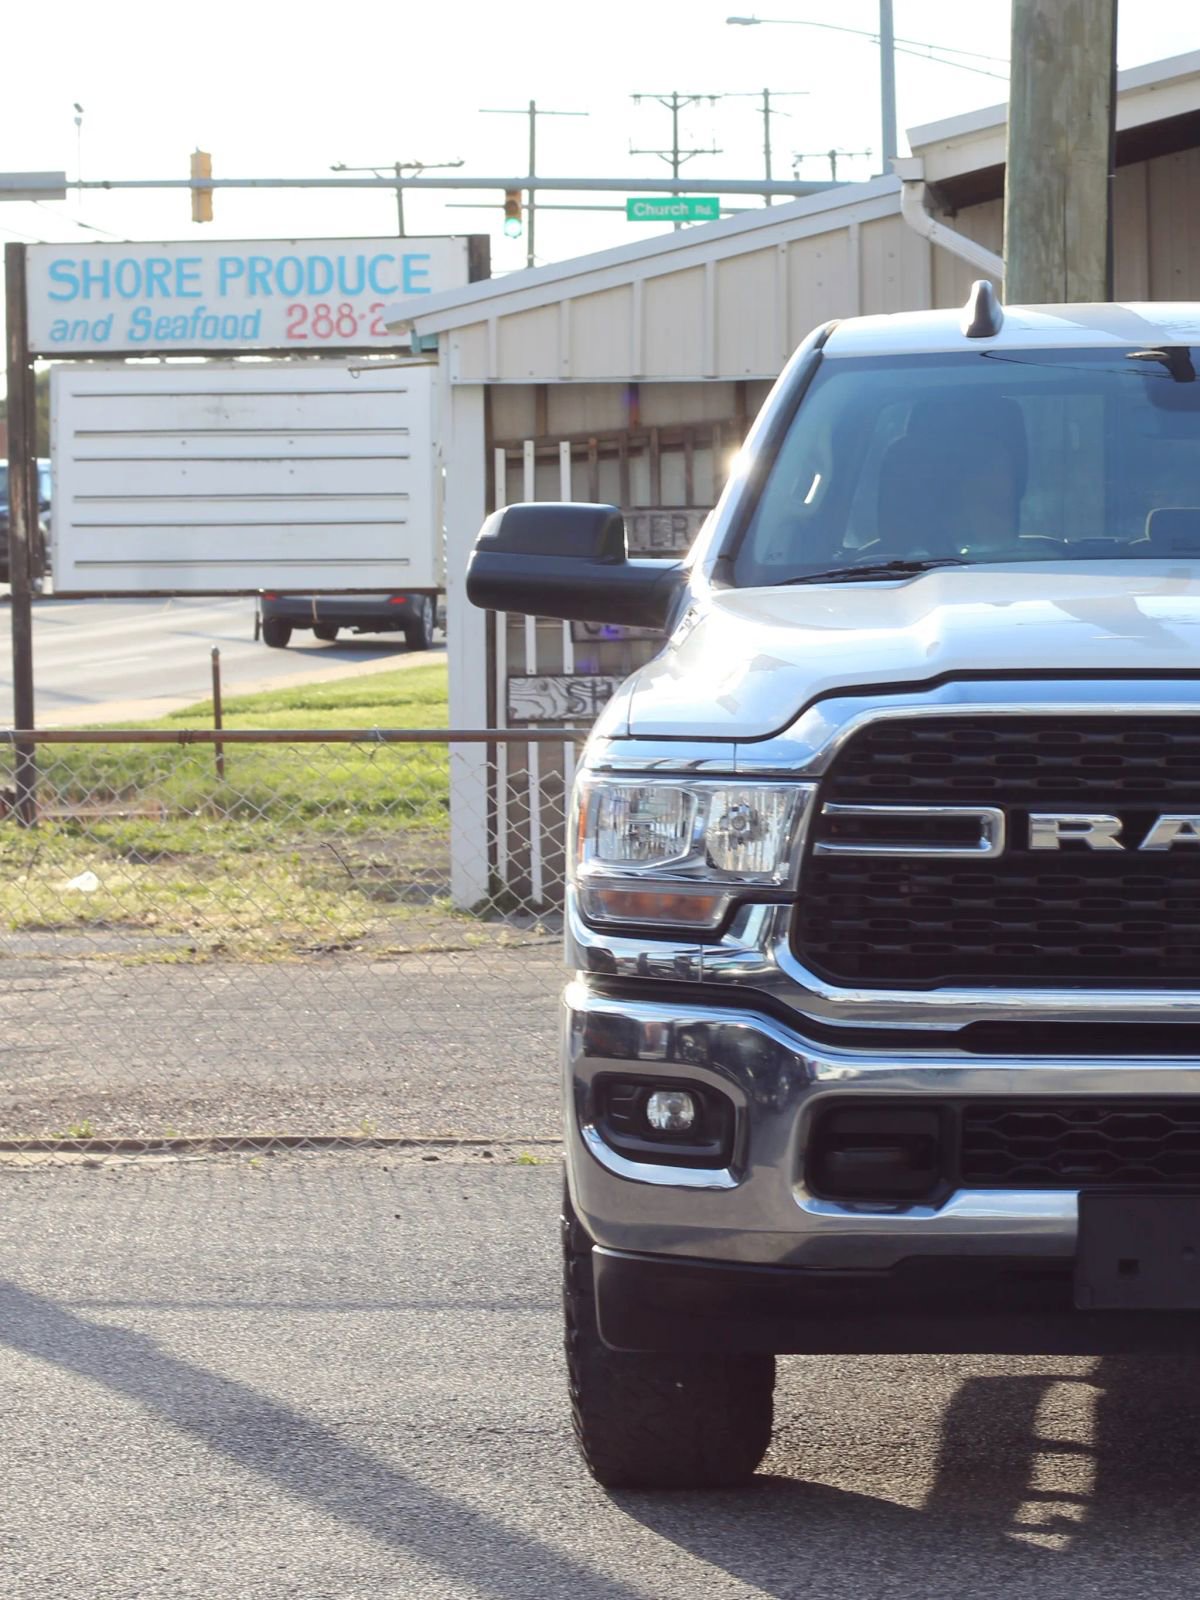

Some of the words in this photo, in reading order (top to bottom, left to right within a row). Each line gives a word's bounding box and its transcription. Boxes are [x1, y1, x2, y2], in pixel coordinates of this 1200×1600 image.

[633, 201, 689, 217] Church
[47, 258, 203, 302] SHORE
[218, 253, 432, 297] PRODUCE
[50, 312, 114, 342] and
[127, 305, 262, 342] Seafood
[286, 302, 408, 340] 288-2
[625, 514, 706, 547] TER
